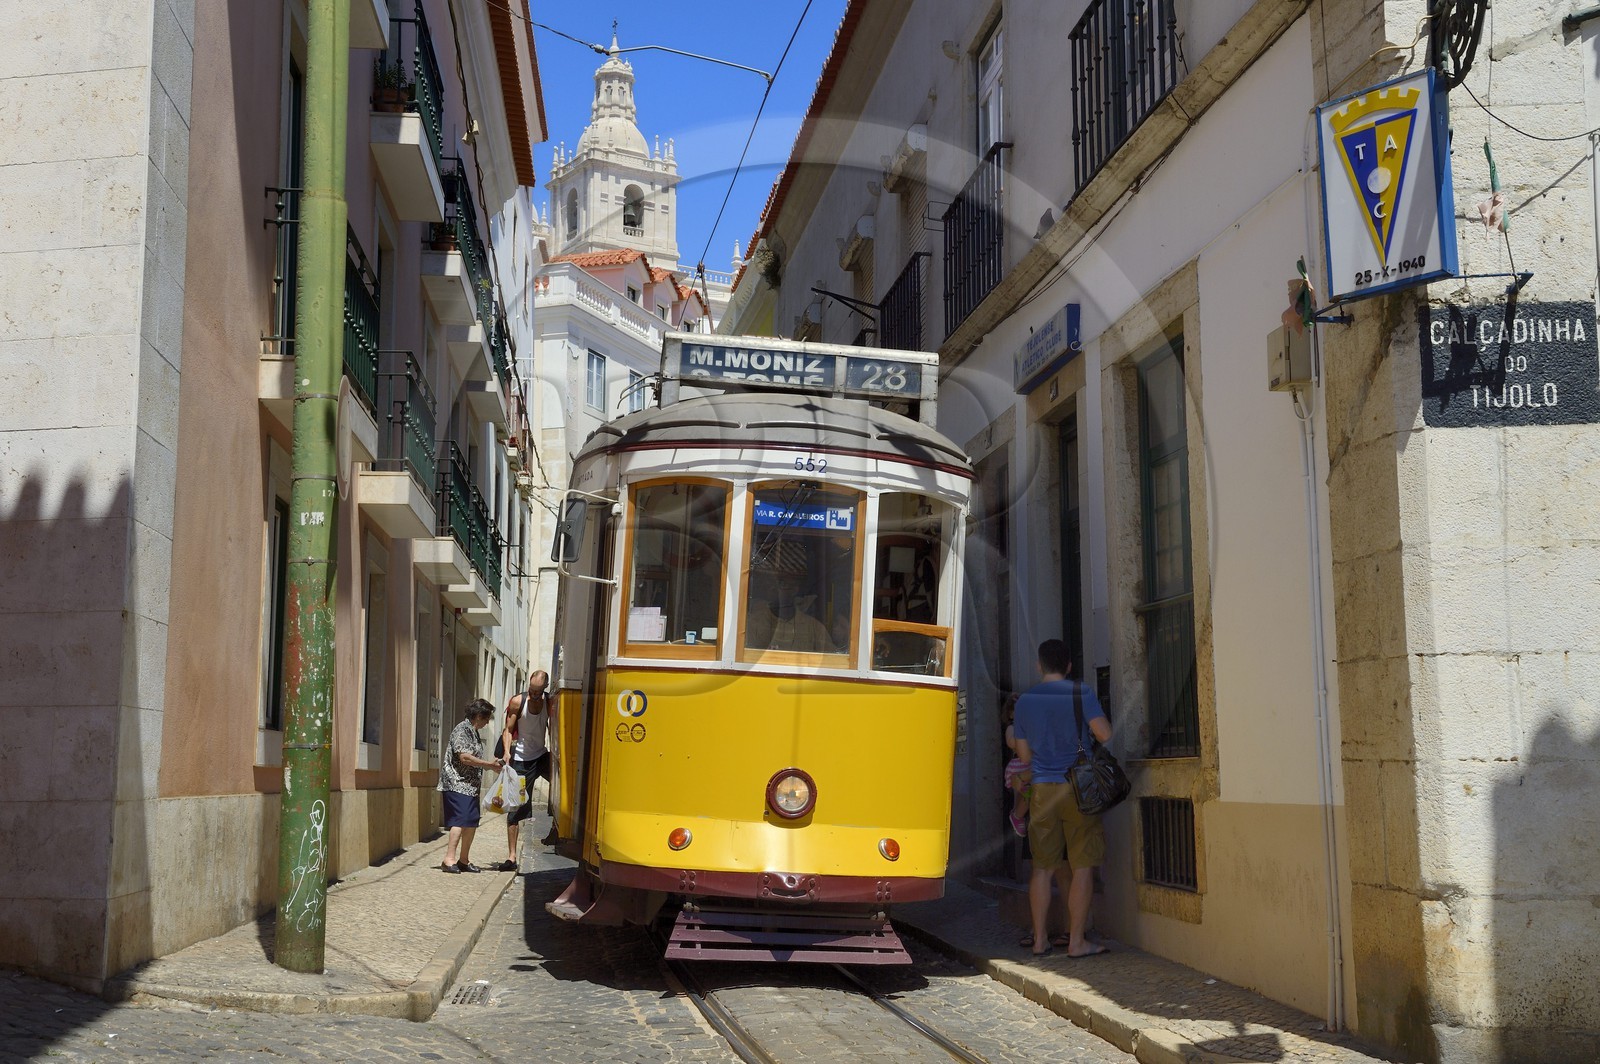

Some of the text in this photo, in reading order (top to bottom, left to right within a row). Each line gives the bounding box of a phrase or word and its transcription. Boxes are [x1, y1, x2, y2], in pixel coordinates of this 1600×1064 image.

[1355, 134, 1398, 160] T A
[1373, 201, 1386, 219] C
[1355, 255, 1426, 286] 25-X-1940
[1430, 318, 1586, 351] CALÇADINHA
[689, 346, 906, 391] M.MONIZ 28
[1504, 355, 1528, 373] DO
[1470, 382, 1558, 408] TIJOLO
[794, 457, 828, 474] 552
[756, 509, 767, 517] VIA
